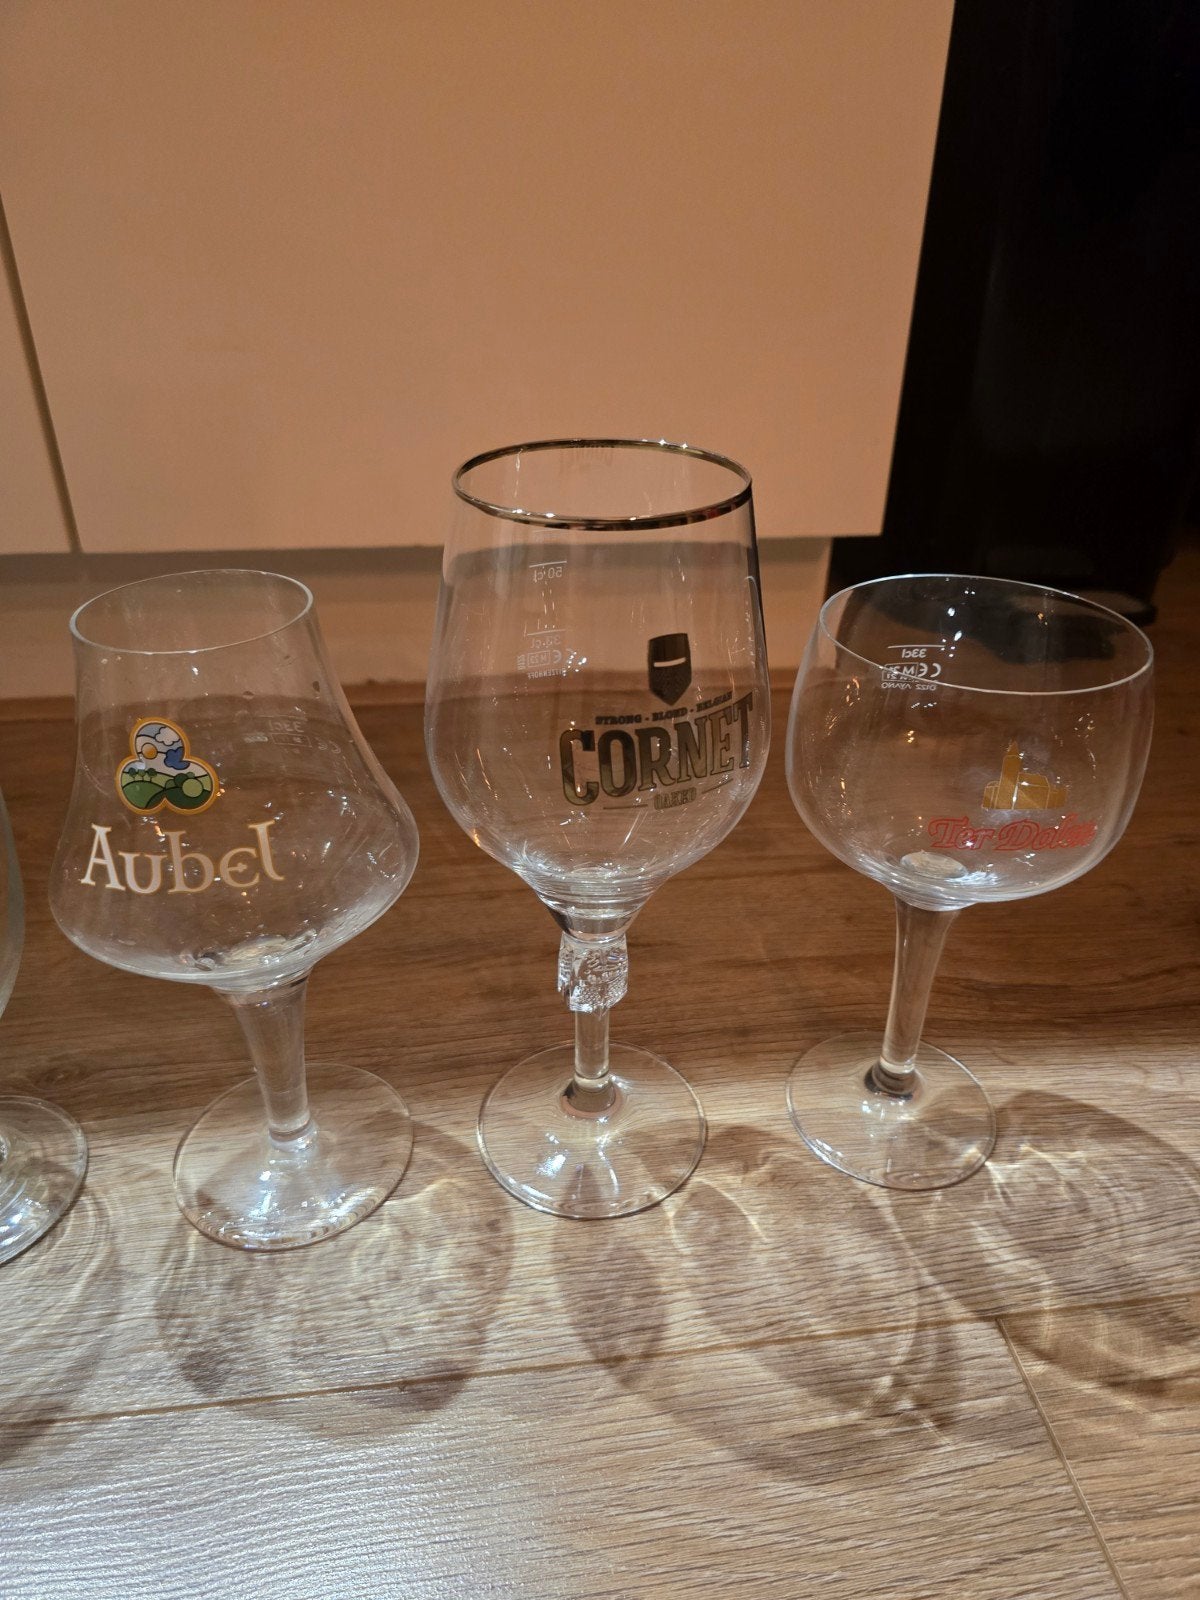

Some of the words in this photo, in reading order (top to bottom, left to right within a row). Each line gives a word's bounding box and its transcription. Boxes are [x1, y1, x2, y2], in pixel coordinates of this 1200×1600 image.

[595, 714, 642, 725] STRONG
[652, 707, 688, 722] BLOND
[559, 691, 754, 806] CORNET
[80, 819, 285, 894] Aubel
[928, 815, 994, 851] Ter
